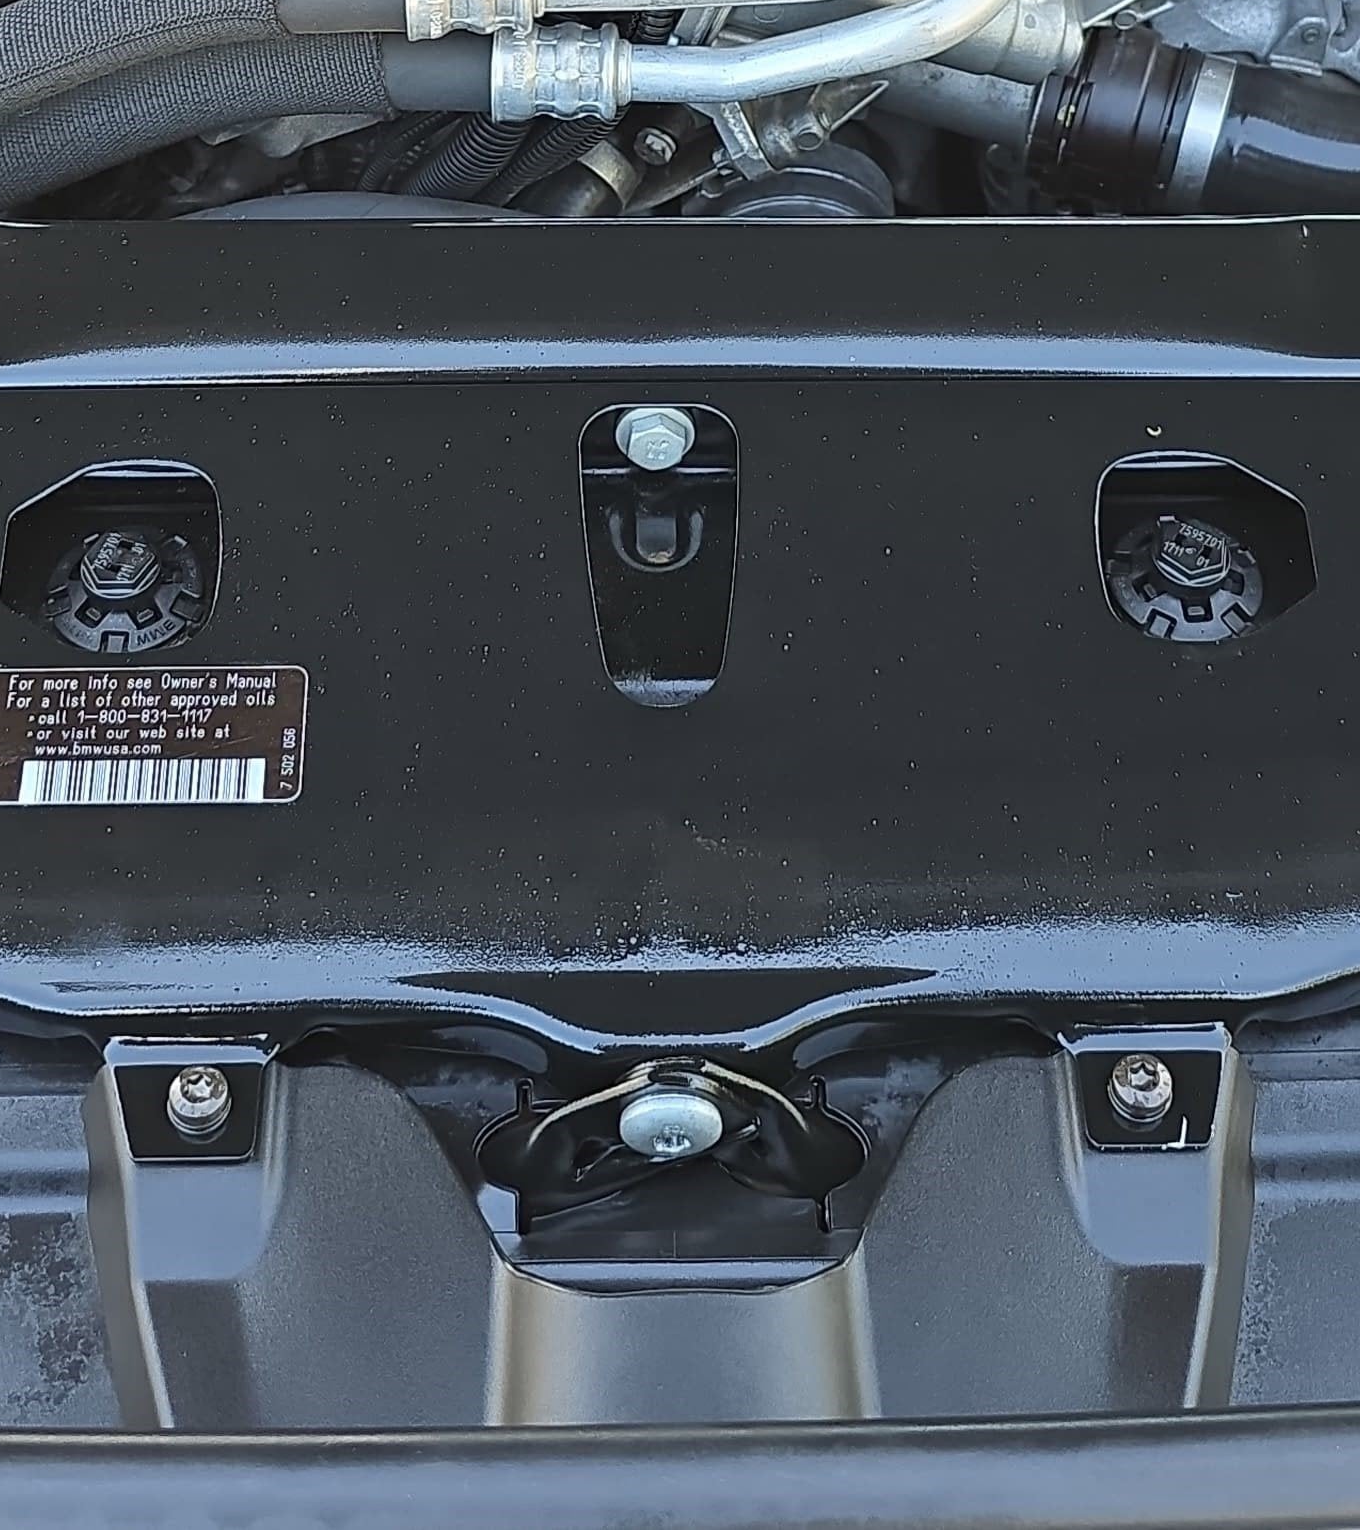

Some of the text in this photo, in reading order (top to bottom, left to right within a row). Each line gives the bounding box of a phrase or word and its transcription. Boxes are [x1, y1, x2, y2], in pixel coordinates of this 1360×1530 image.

[1178, 523, 1223, 550] 7595701
[8, 673, 35, 691] For
[42, 677, 79, 690] more
[126, 677, 152, 690] see
[161, 672, 218, 690] Owner's
[225, 671, 277, 688] Manual
[6, 690, 276, 710] For a list of other approved oils
[77, 708, 212, 725] 1-800-831-1117
[36, 723, 230, 741] or visit our web site at
[35, 741, 162, 756] www.bmwusa.com
[280, 727, 297, 791] 7 502 056
